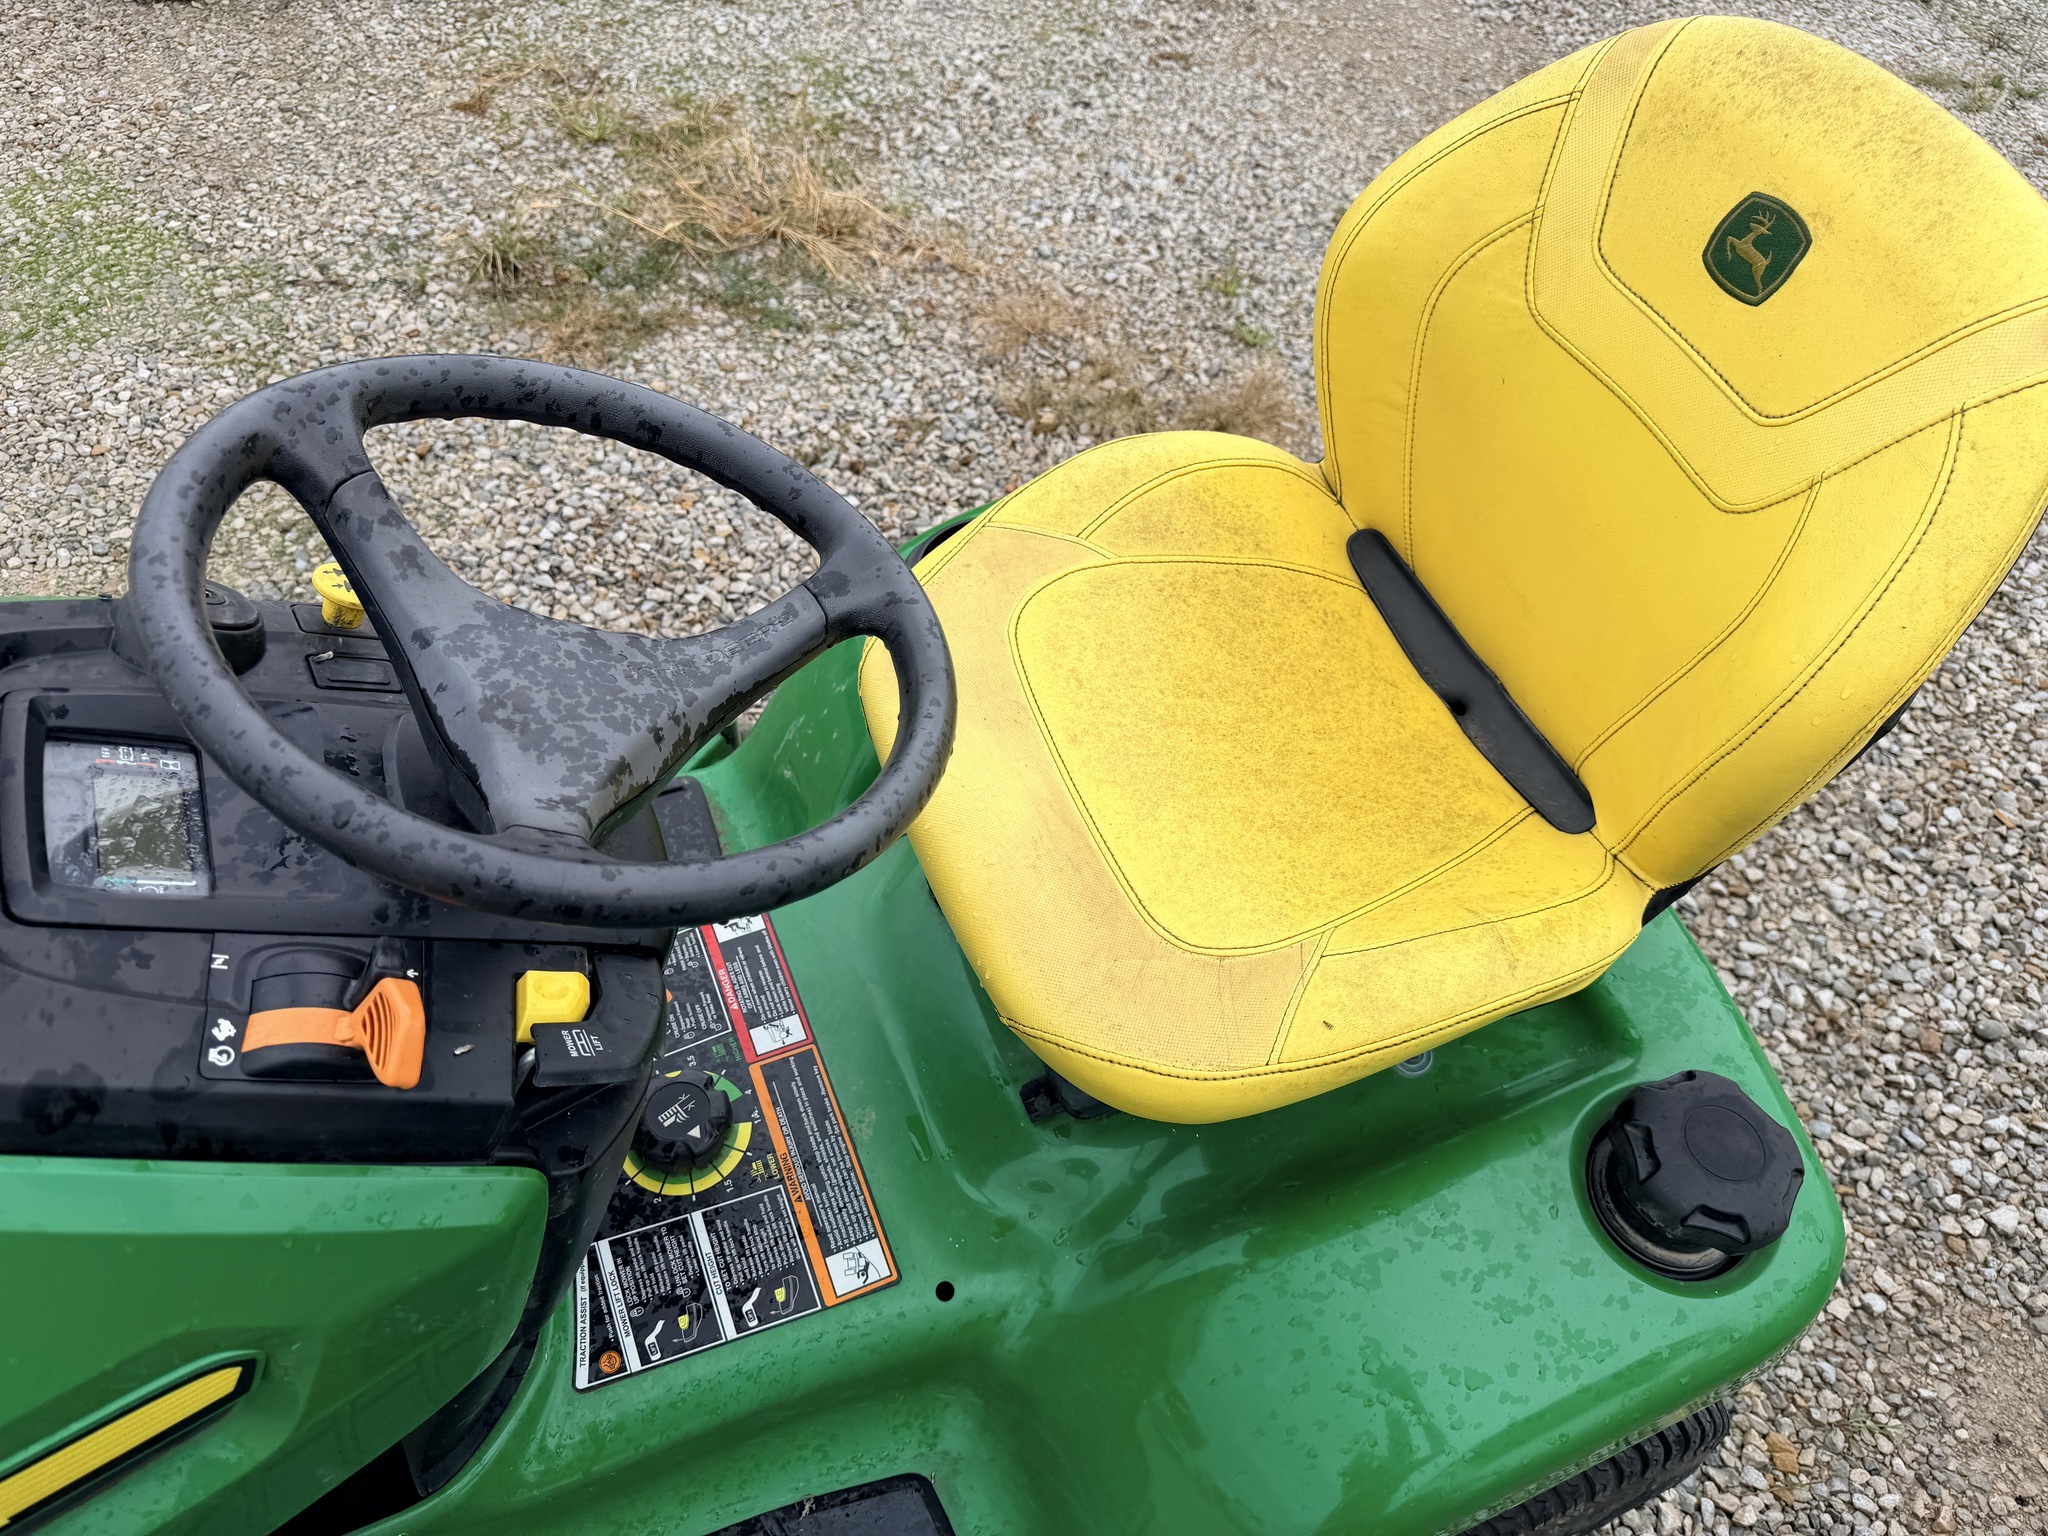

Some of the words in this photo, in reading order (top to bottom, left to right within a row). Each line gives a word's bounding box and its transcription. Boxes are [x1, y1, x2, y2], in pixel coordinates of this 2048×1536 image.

[702, 611, 795, 665] DEERE
[718, 968, 736, 1003] DANGER
[561, 1030, 579, 1057] MOWER
[590, 1034, 604, 1050] LIFT
[728, 1036, 741, 1062] HIGHER
[686, 1055, 697, 1067] 3.5
[776, 1106, 786, 1126] DEATH
[782, 1125, 789, 1135] OR
[785, 1136, 796, 1157] INJURY
[766, 1152, 780, 1180] LOWER
[780, 1152, 799, 1196] WARNING
[792, 1156, 805, 1183] SERIOUS
[724, 1180, 734, 1192] 1.5
[801, 1182, 811, 1200] AVOID
[654, 1196, 662, 1204] 2
[660, 1226, 668, 1236] TO
[663, 1236, 674, 1260] MOWER
[669, 1235, 680, 1258] HEIGHT
[710, 1232, 721, 1255] HEIGHT
[676, 1258, 684, 1271] CUT
[705, 1252, 718, 1279] HEIGHT
[717, 1255, 725, 1268] CUT
[608, 1270, 619, 1291] LOCK
[618, 1264, 628, 1288] MOWER
[625, 1266, 637, 1295] POSITION
[670, 1260, 682, 1287] UNLOCK
[680, 1272, 688, 1284] SET
[721, 1269, 729, 1282] SET
[713, 1280, 723, 1295] CUT
[724, 1281, 732, 1292] TO
[613, 1292, 623, 1308] LIFT
[624, 1288, 634, 1307] LOCK
[631, 1295, 640, 1305] UP
[618, 1308, 630, 1338] MOWER
